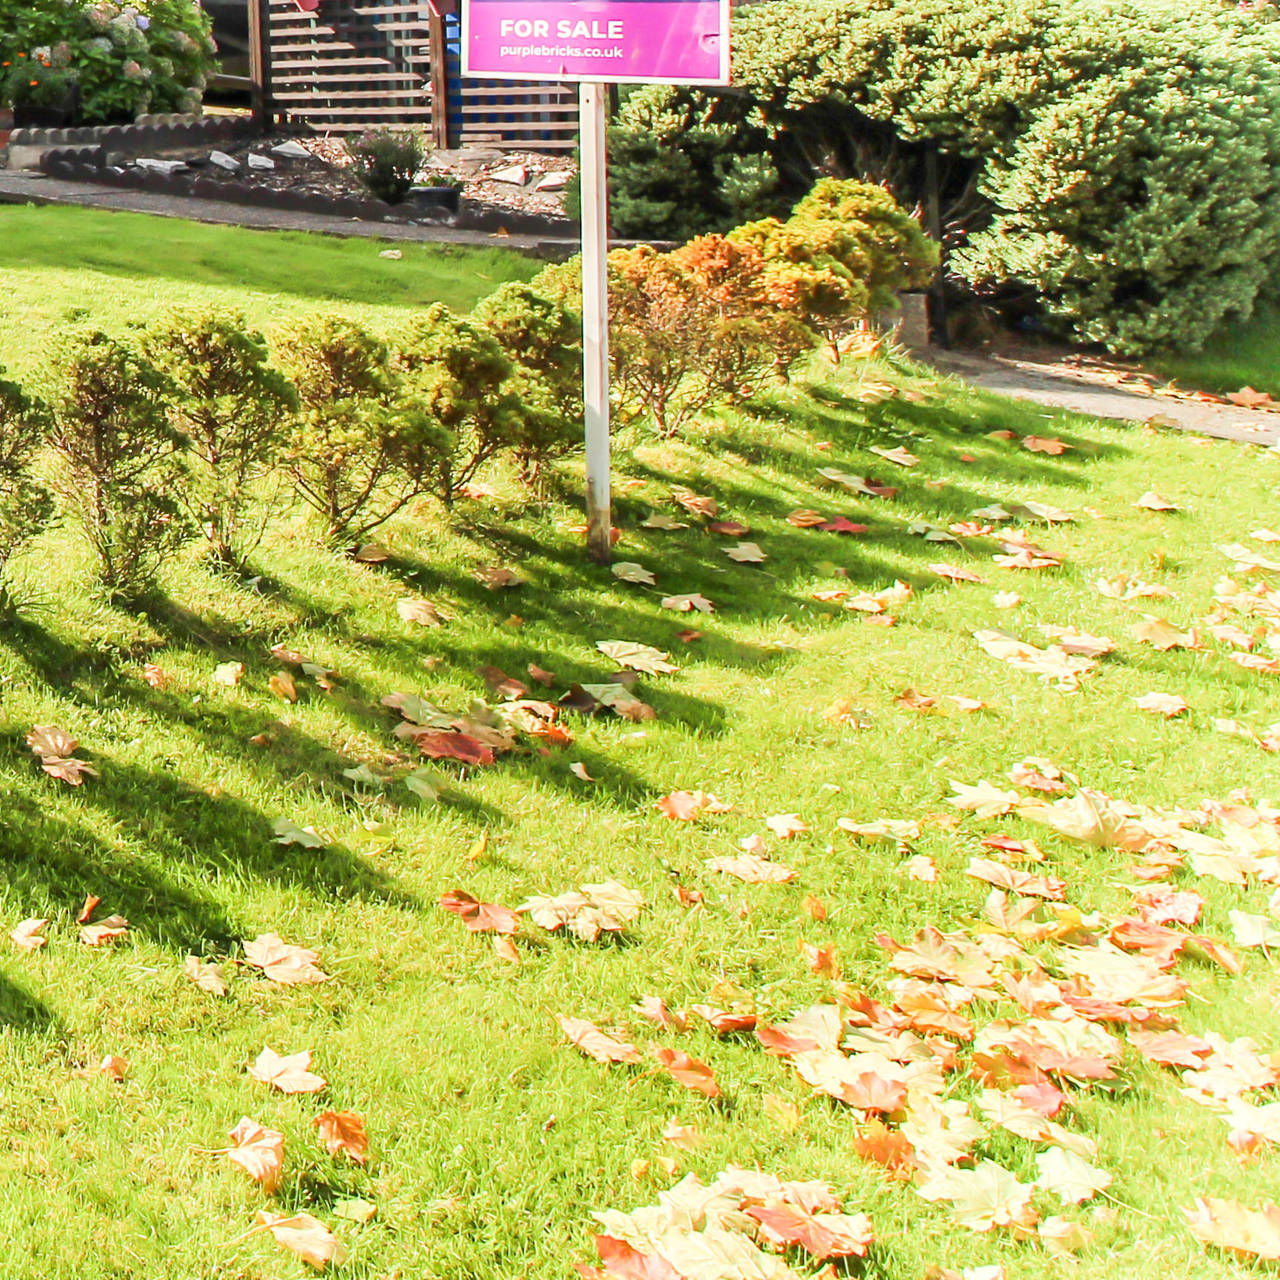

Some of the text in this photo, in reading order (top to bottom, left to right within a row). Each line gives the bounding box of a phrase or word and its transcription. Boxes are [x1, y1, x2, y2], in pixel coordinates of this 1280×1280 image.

[500, 19, 624, 39] FOR SALE
[500, 44, 623, 58] purplebricks.co.uk
